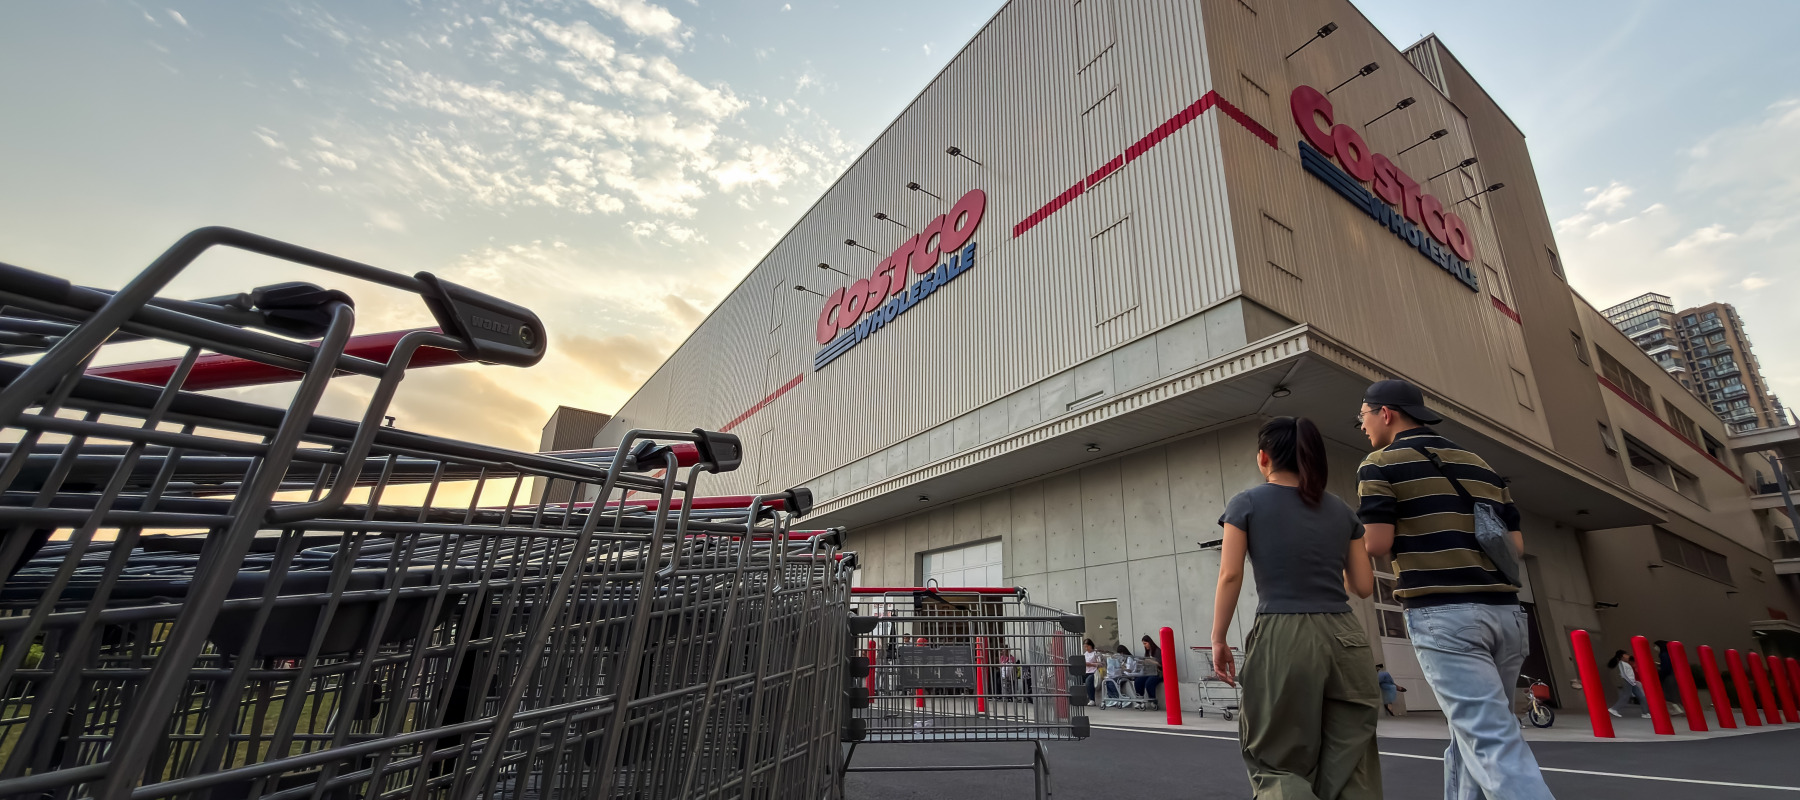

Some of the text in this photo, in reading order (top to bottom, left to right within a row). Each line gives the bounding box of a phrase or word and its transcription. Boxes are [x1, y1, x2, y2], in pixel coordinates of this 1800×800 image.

[1290, 85, 1475, 262] COSTCO
[816, 188, 986, 345] COSTCO
[854, 242, 977, 345] WHOLESALE
[1367, 190, 1480, 293] WHOLESALE
